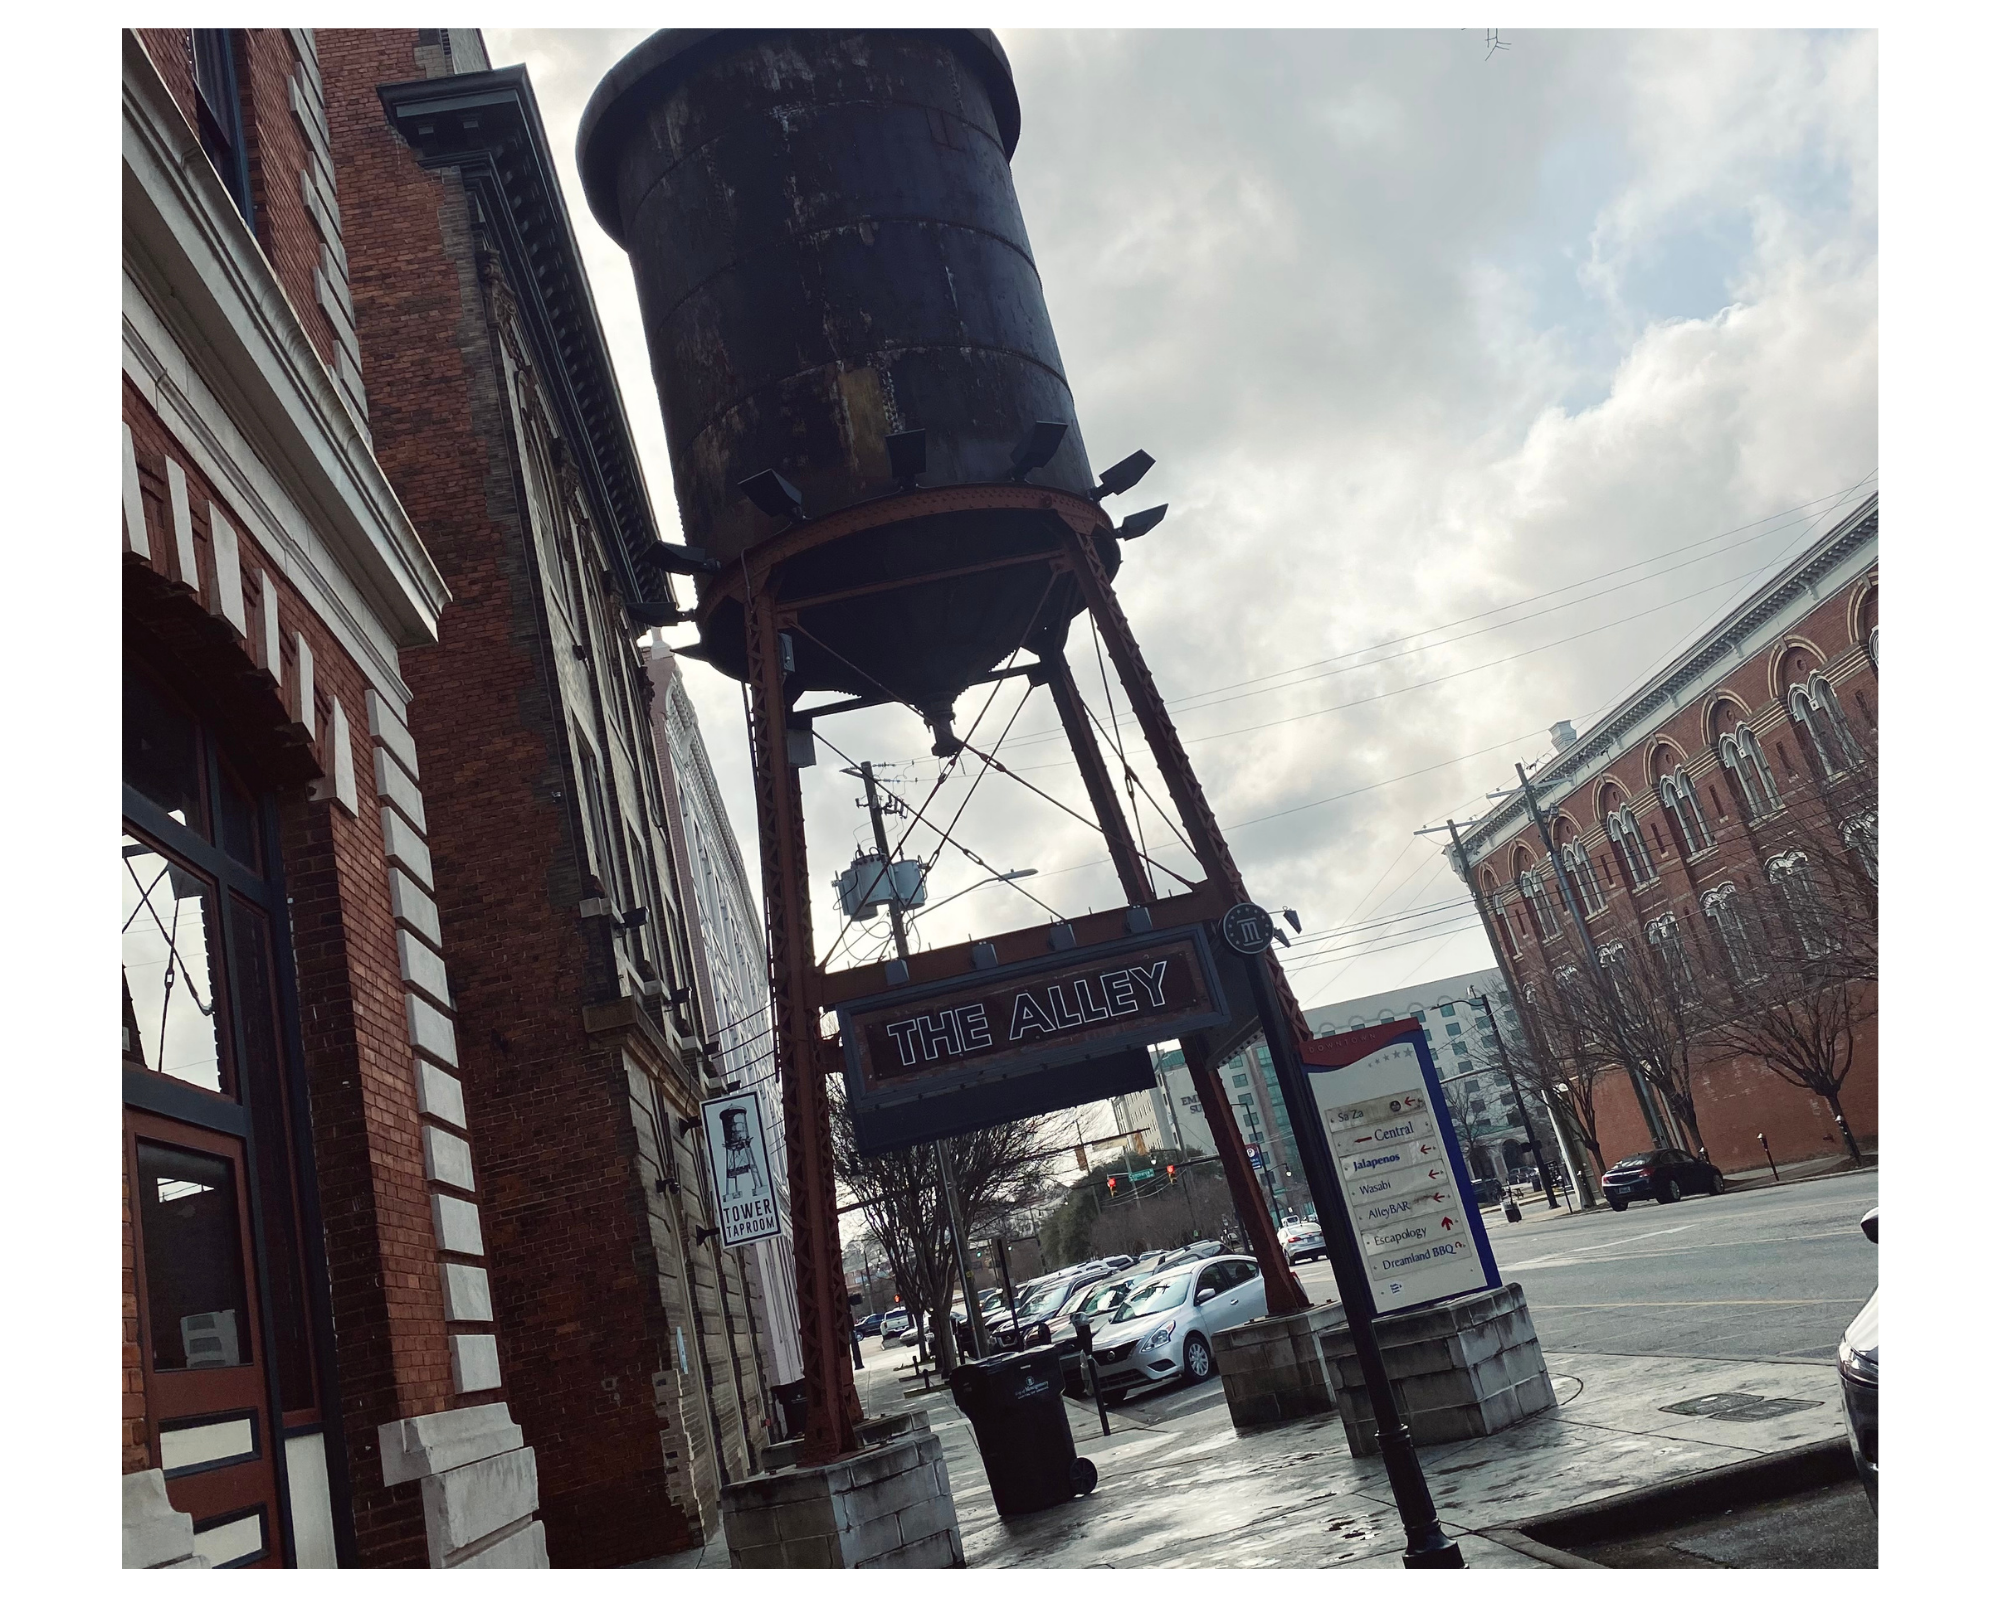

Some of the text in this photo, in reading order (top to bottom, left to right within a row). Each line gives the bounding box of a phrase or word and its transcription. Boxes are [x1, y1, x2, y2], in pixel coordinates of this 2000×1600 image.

[887, 961, 1167, 1066] THE ALLEY
[1309, 1033, 1376, 1053] DOWNTOWN
[1374, 1121, 1414, 1141] Central
[1353, 1153, 1400, 1171] Jalapenos
[1359, 1180, 1391, 1195] Wasabi
[723, 1198, 772, 1224] TOWER
[1369, 1201, 1410, 1220] AlleyBAR
[726, 1216, 775, 1238] TAPROOM
[1374, 1227, 1427, 1246] Escapology
[1382, 1243, 1456, 1270] Dreamland BBQ
